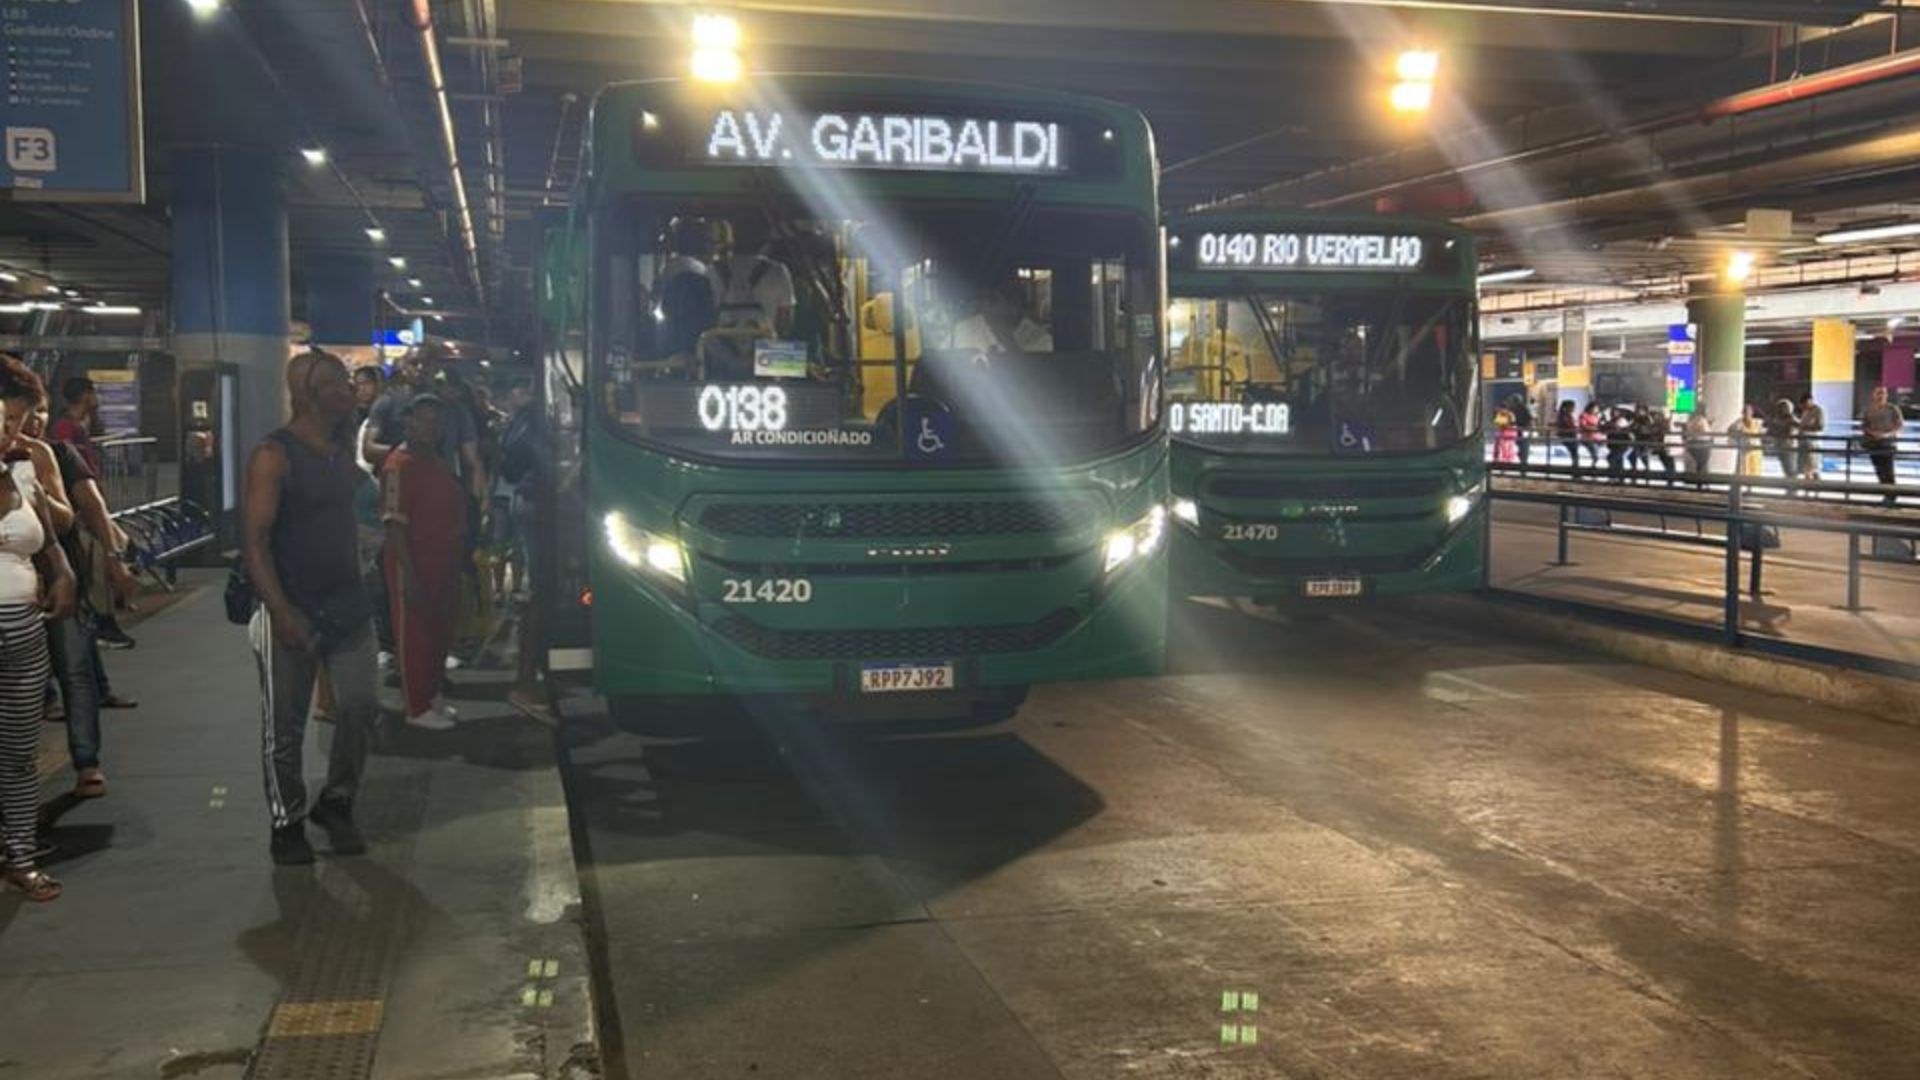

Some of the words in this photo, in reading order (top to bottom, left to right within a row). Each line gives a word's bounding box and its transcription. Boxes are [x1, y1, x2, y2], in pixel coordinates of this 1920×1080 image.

[14, 137, 50, 161] F3
[708, 110, 793, 159] AV.
[811, 114, 1059, 168] GARIBALDI
[1200, 233, 1256, 264] 0140
[1263, 234, 1299, 264] RIO
[1306, 235, 1422, 266] VERMELHO
[698, 384, 787, 431] 0138
[731, 430, 753, 445] AR
[1223, 524, 1278, 541] 21470
[722, 579, 812, 602] 21420
